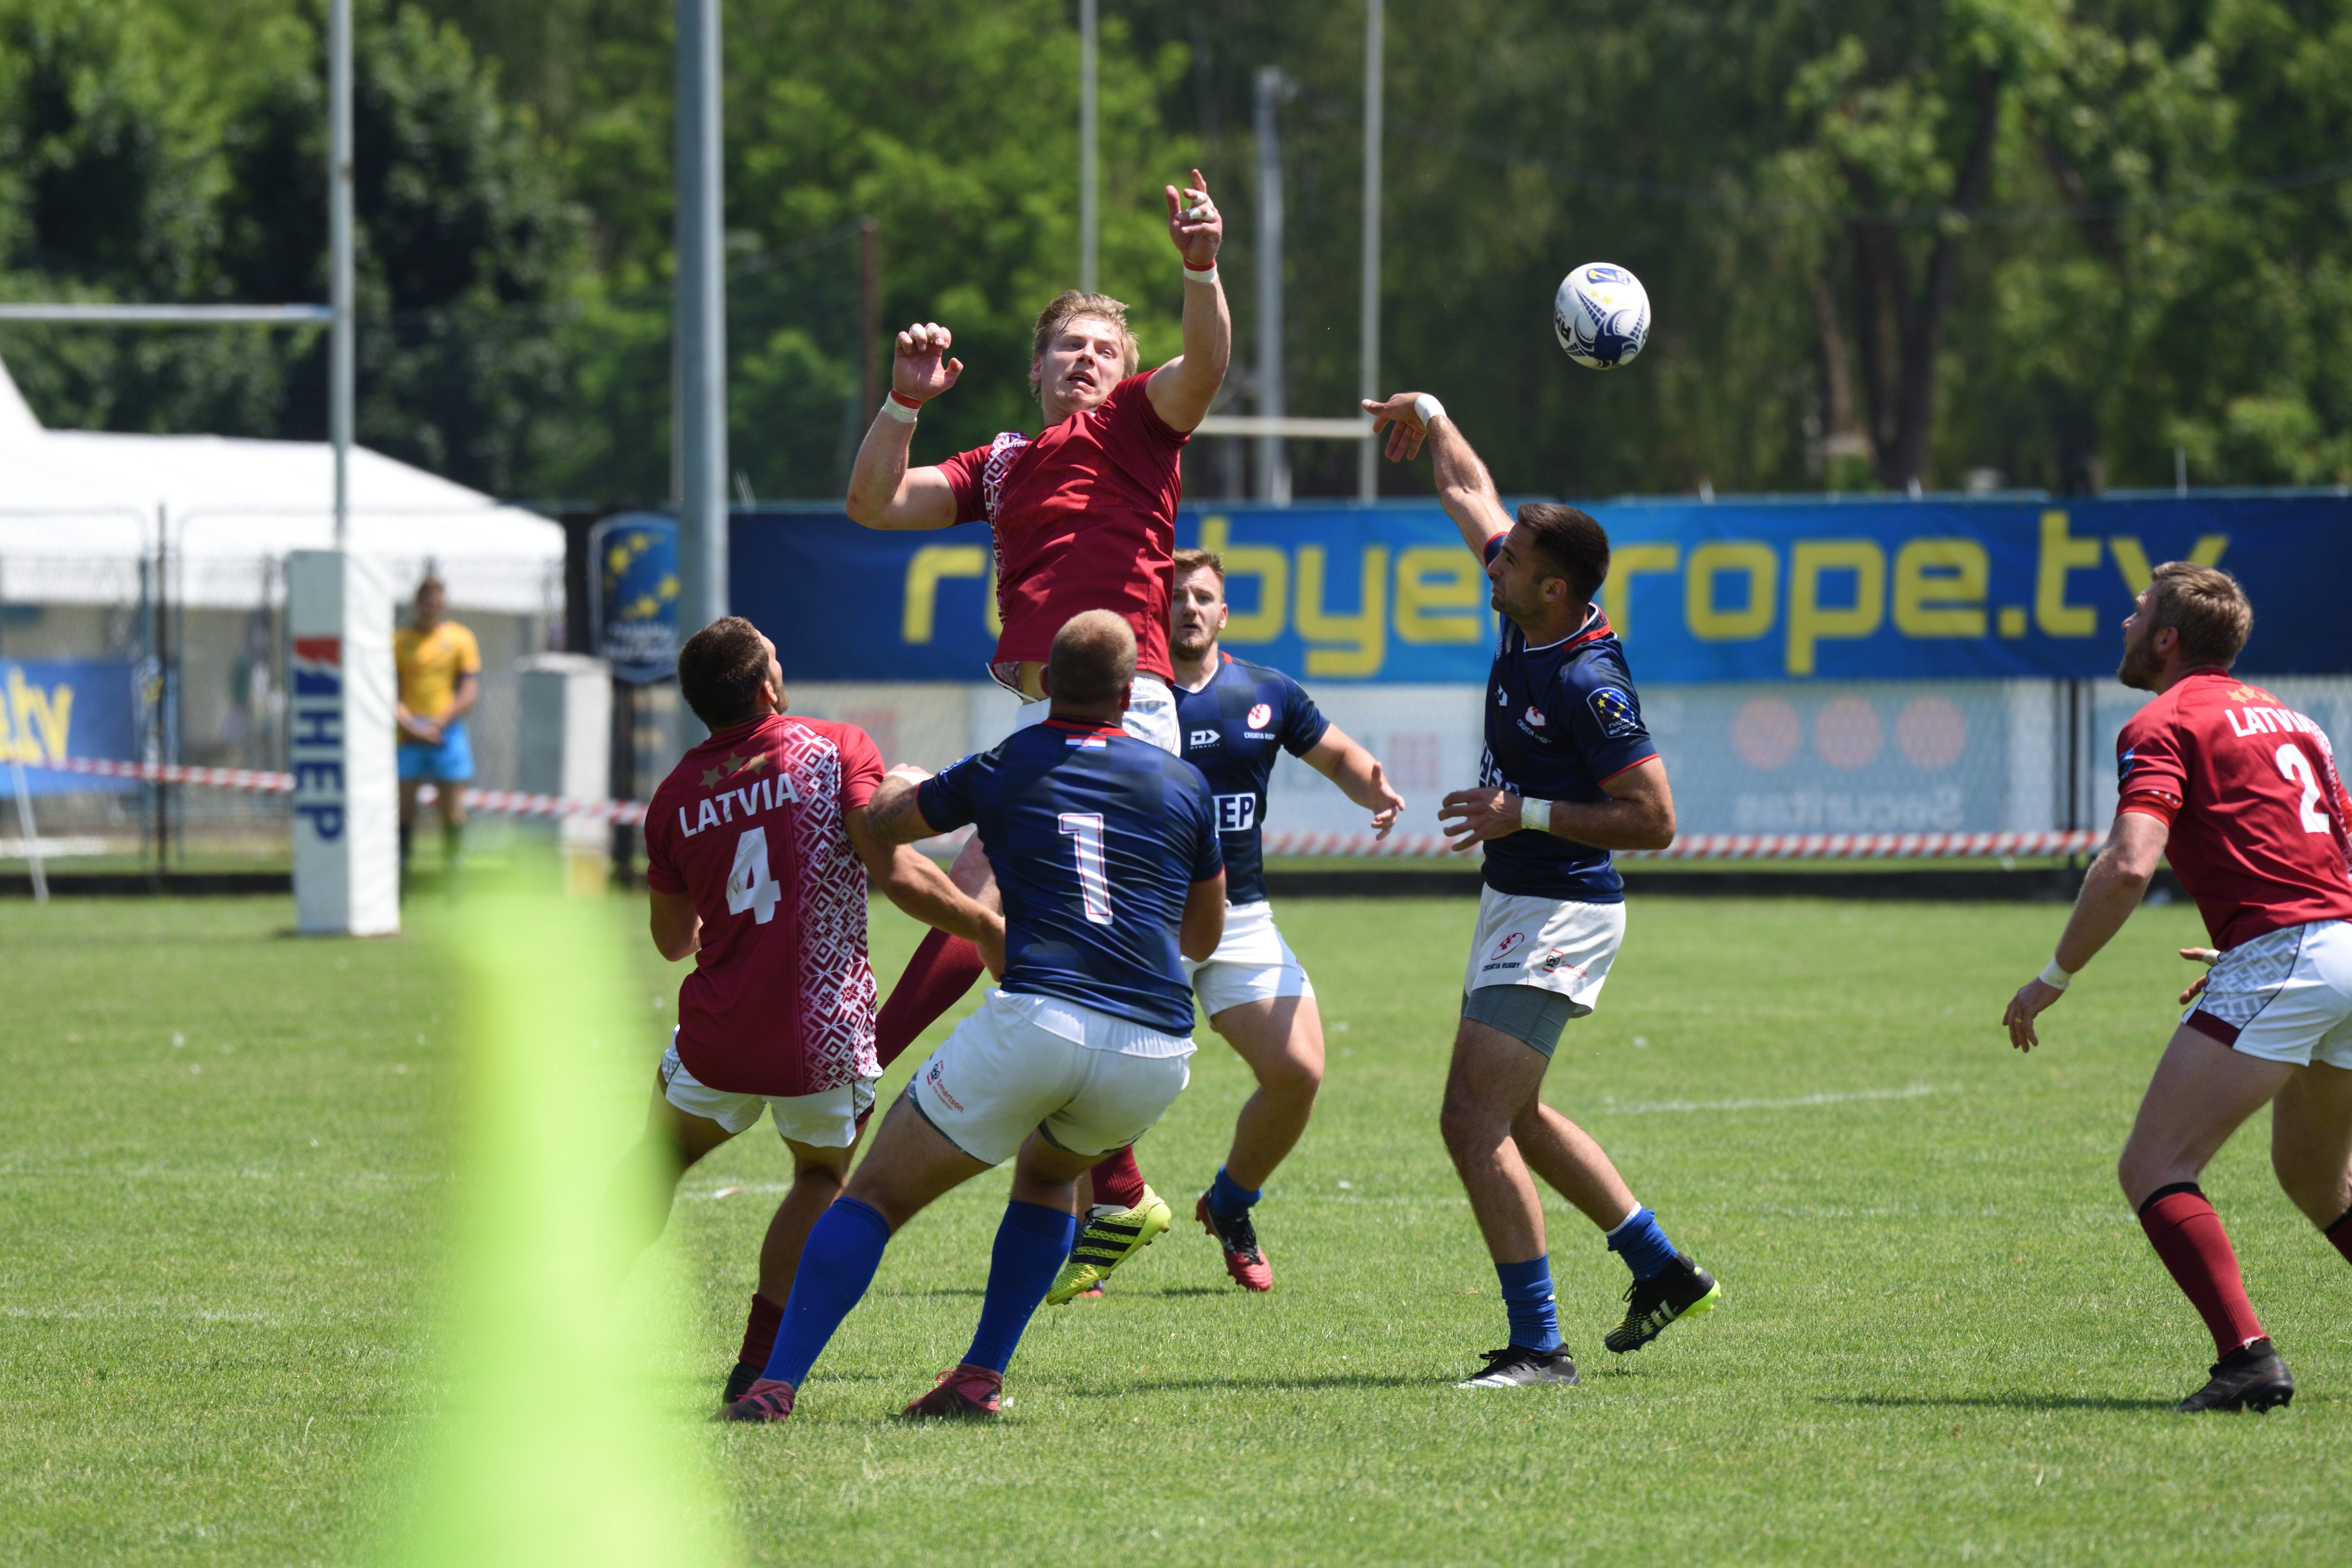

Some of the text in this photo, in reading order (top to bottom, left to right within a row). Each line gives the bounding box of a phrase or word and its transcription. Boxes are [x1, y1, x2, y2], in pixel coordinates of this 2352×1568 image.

[1609, 723, 1636, 735] europ
[2225, 707, 2311, 737] LATVIA
[294, 709, 345, 843] HEP
[679, 772, 800, 838] LATVIA
[2275, 743, 2331, 835] 2
[726, 826, 781, 925] 4
[1058, 812, 1113, 925] 1
[1483, 963, 1501, 972] CROATIA
